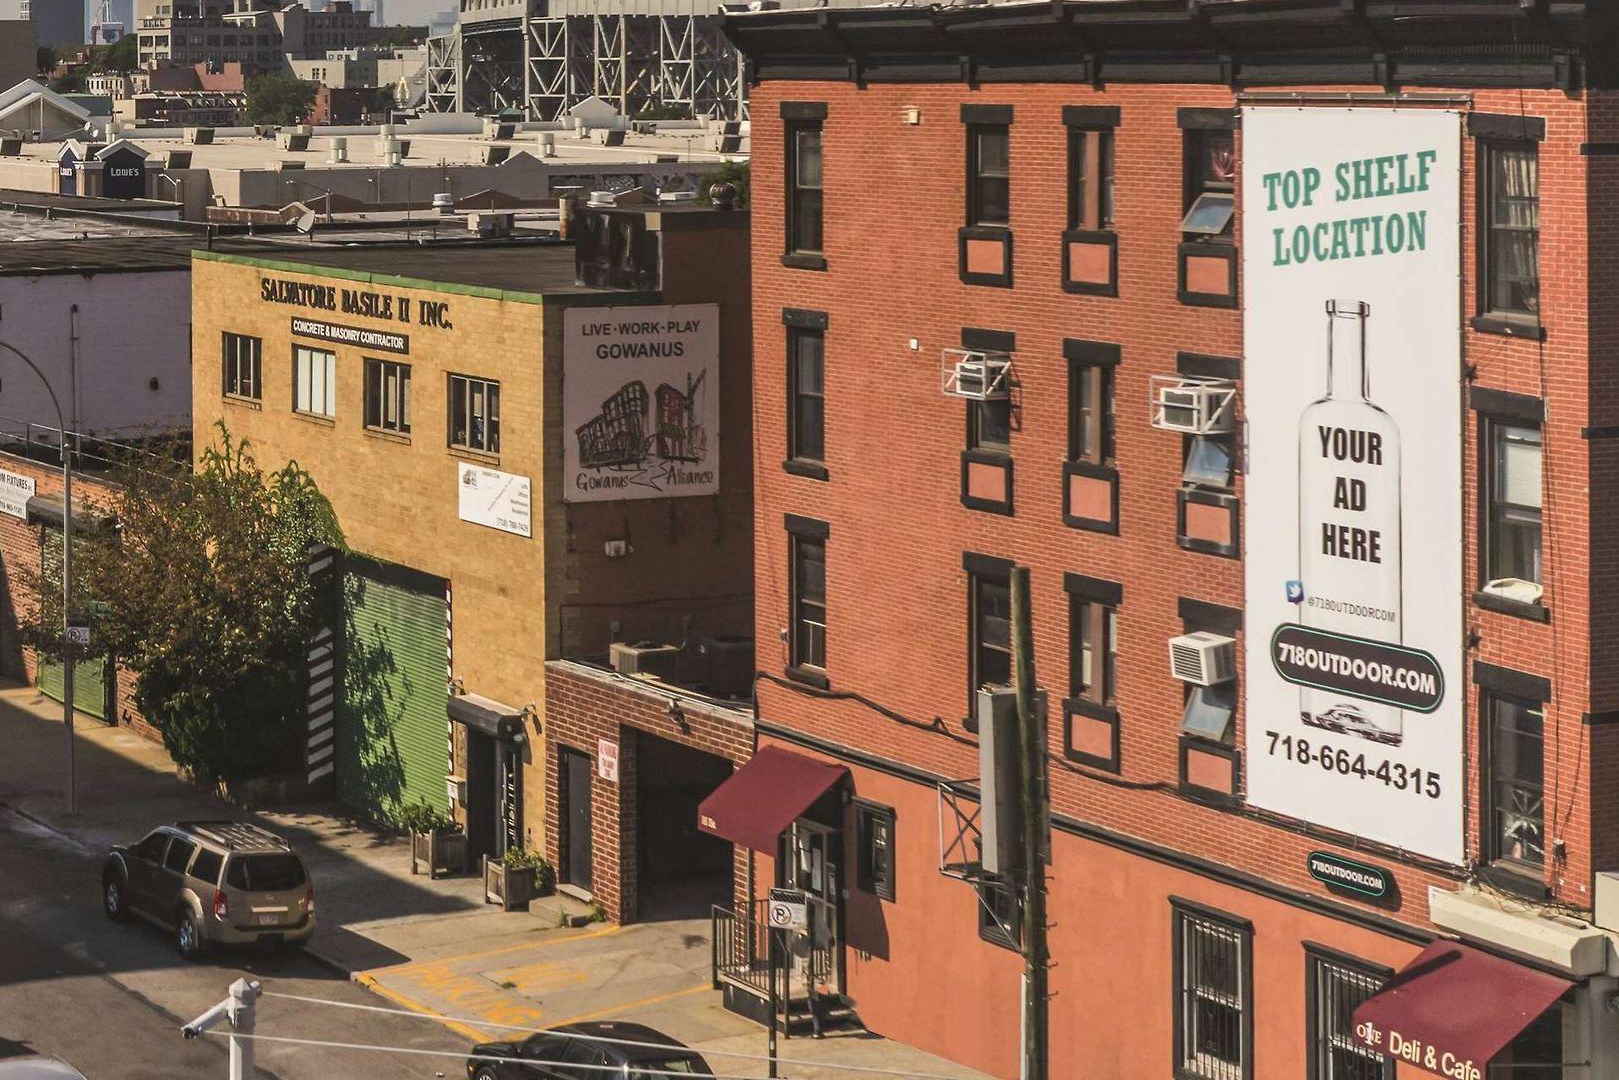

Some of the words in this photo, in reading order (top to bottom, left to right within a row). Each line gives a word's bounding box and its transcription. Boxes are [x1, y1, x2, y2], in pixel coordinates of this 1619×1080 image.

[1263, 167, 1321, 211] TOP
[1335, 150, 1436, 202] SHELF
[1273, 210, 1427, 266] LOCATION
[261, 278, 336, 311] SALVATORE
[341, 289, 392, 320] BASILE
[398, 297, 410, 323] II
[419, 300, 453, 330] INC.
[293, 320, 325, 336] CONCRETE
[325, 325, 330, 336] &
[331, 327, 360, 342] MASONRY
[361, 330, 404, 349] CONTRACTOR
[582, 323, 611, 336] LIVE
[619, 322, 659, 335] WORK
[668, 320, 700, 333] PLAY
[596, 341, 684, 360] GOWANUS
[1318, 425, 1382, 466] YOUR
[7, 475, 28, 490] FIXTURES
[576, 472, 628, 492] Gowanus
[1333, 476, 1366, 512] AD
[1322, 523, 1381, 564] HERE
[1278, 642, 1435, 695] 718OUTDOOR.COM
[1266, 730, 1441, 799] 718-664-4315
[1311, 860, 1382, 889] 718OUTDOOR.COM
[1389, 1031, 1421, 1063] Deli
[1424, 1045, 1436, 1070] &
[1442, 1052, 1481, 1080] Cafe
